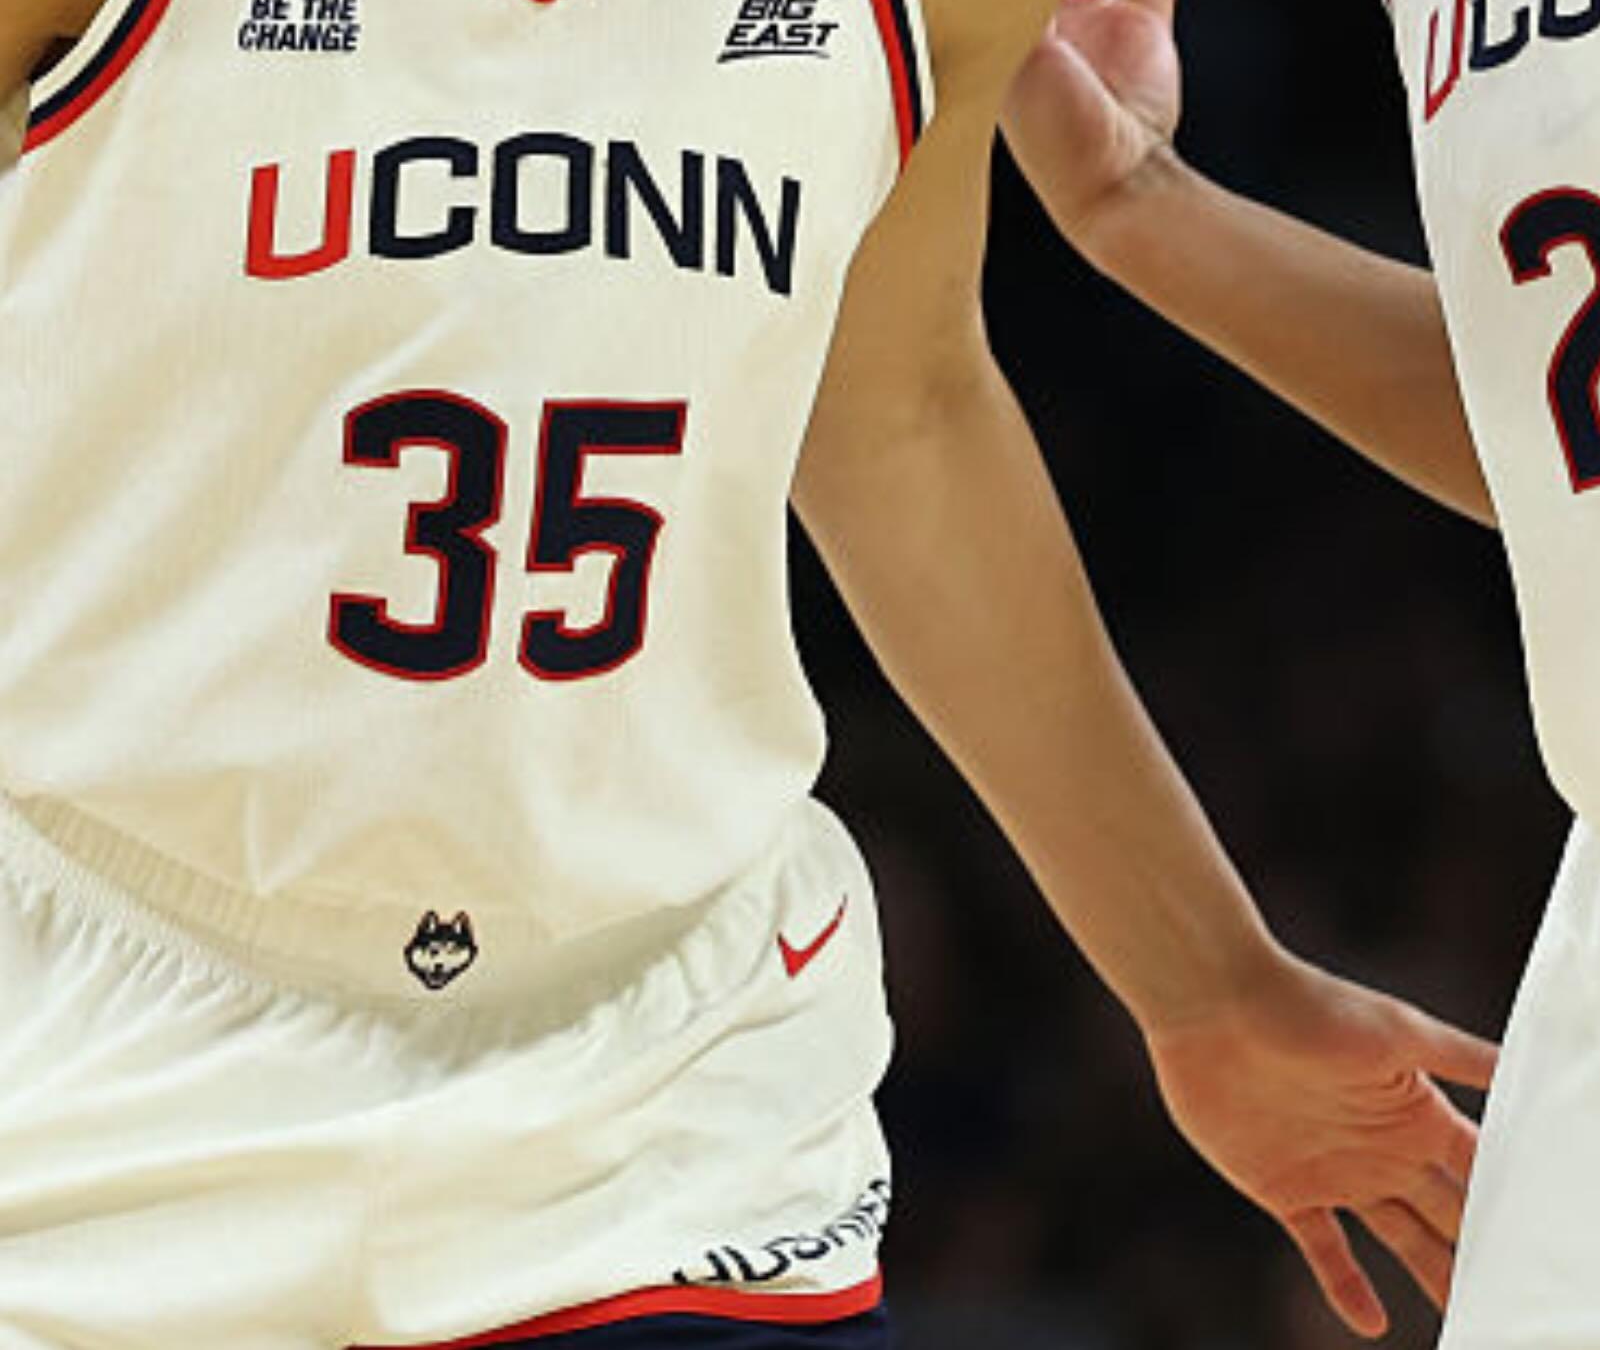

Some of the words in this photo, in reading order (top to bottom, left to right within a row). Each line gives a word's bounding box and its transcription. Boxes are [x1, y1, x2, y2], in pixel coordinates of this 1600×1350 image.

[238, 23, 360, 52] CHANGE
[725, 23, 839, 46] EAST
[244, 132, 801, 298] UCONN
[328, 389, 688, 681] 35
